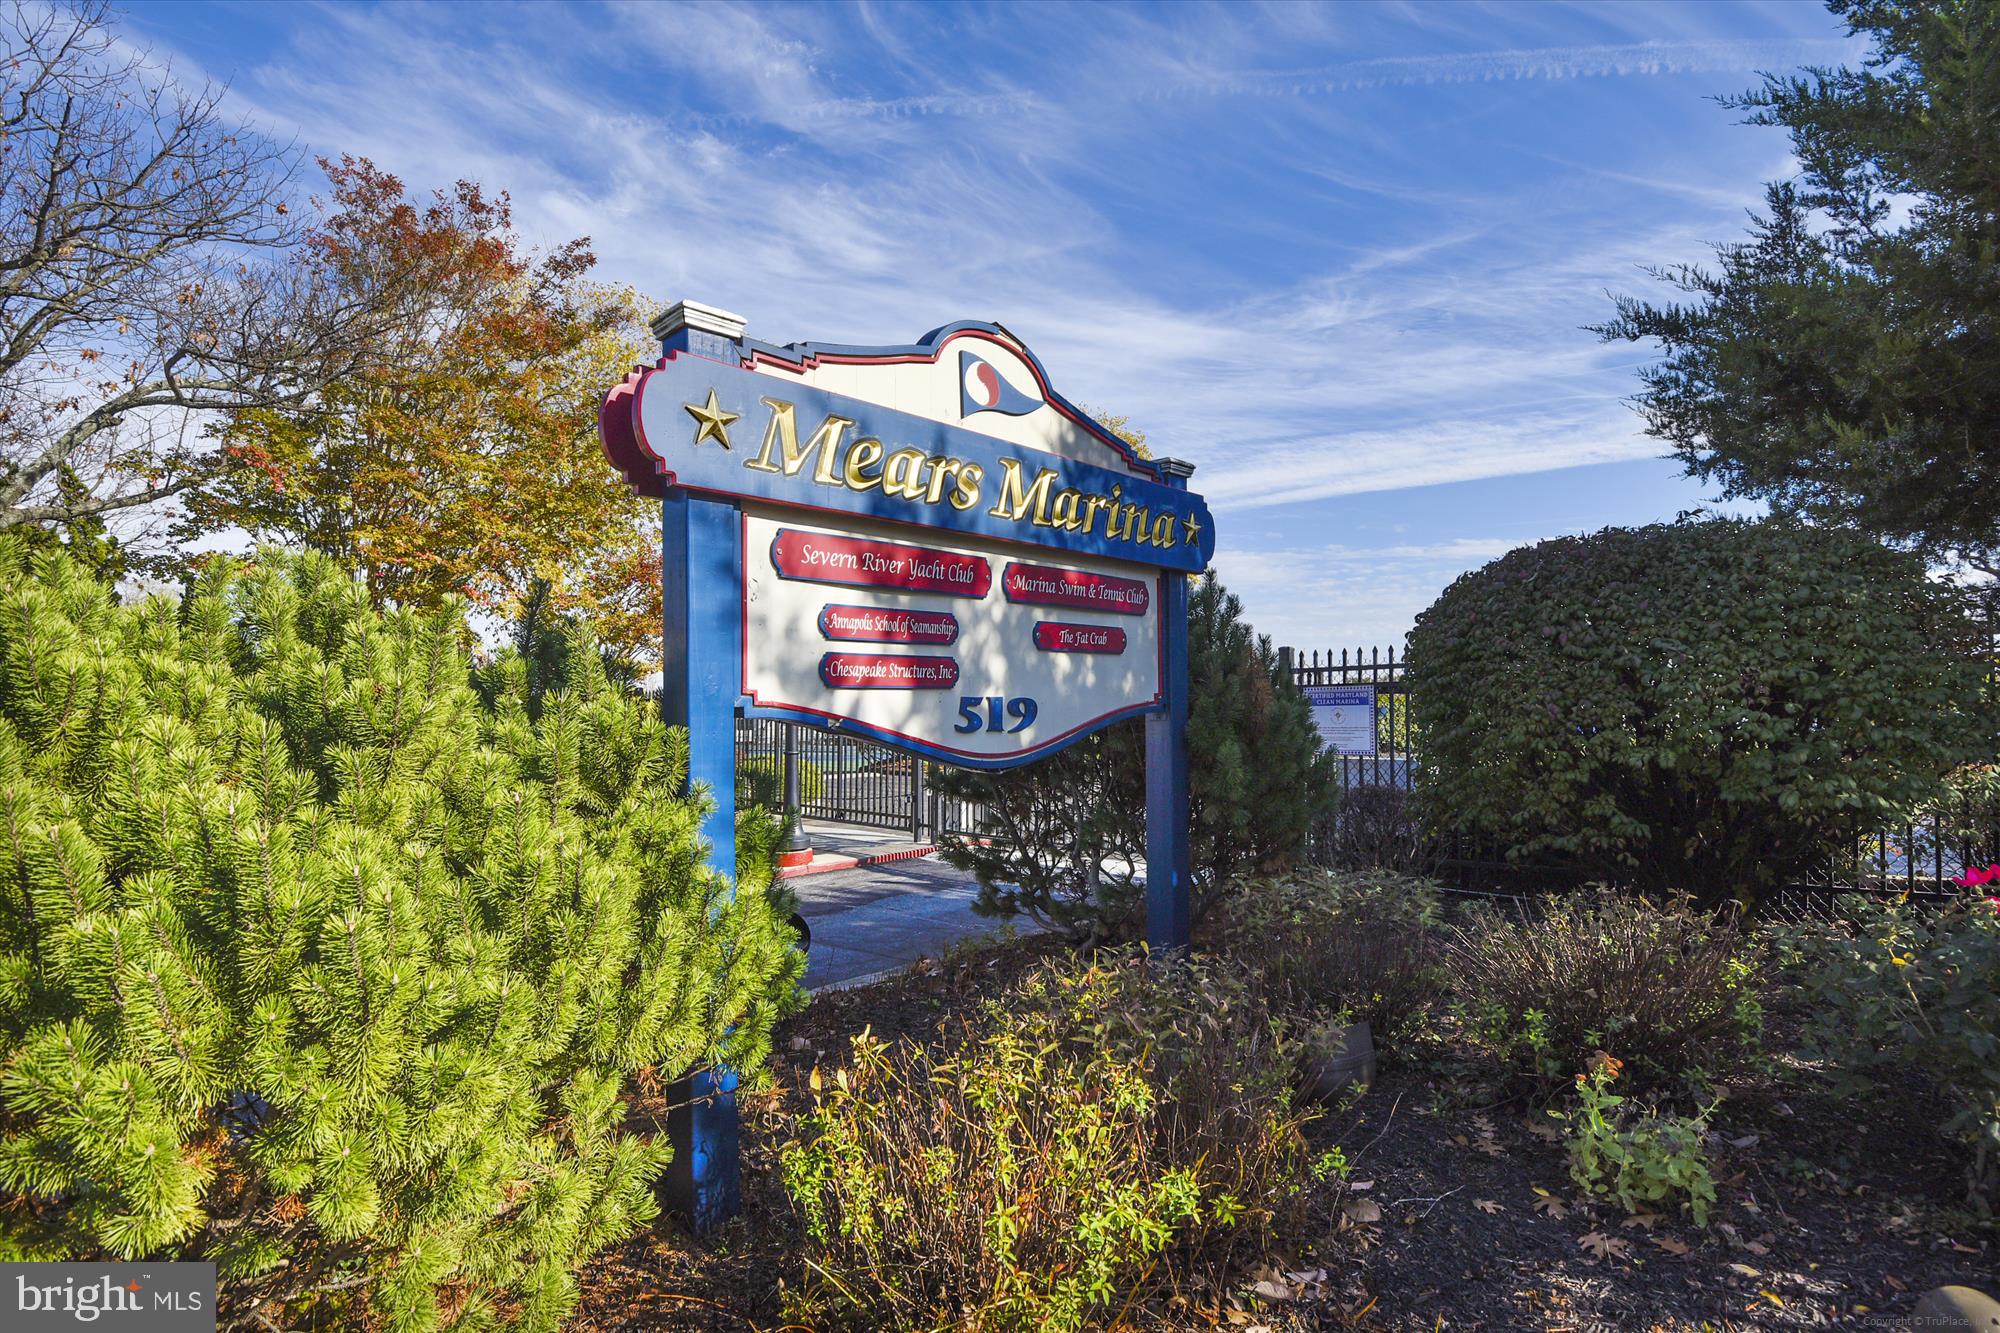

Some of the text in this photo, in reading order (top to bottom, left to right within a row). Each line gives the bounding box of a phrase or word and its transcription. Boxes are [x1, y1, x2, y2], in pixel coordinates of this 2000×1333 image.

[743, 396, 1177, 549] Mears Marina
[801, 544, 974, 583] Severn River Yacht Club
[1012, 574, 1144, 604] Marina Swim & Tennis Club
[829, 613, 955, 640] Annapolis School of Seamanship
[1059, 629, 1108, 647] The Fat Crab
[830, 659, 887, 682] Chesapeake
[888, 662, 937, 680] Structures,
[954, 696, 1038, 734] 519
